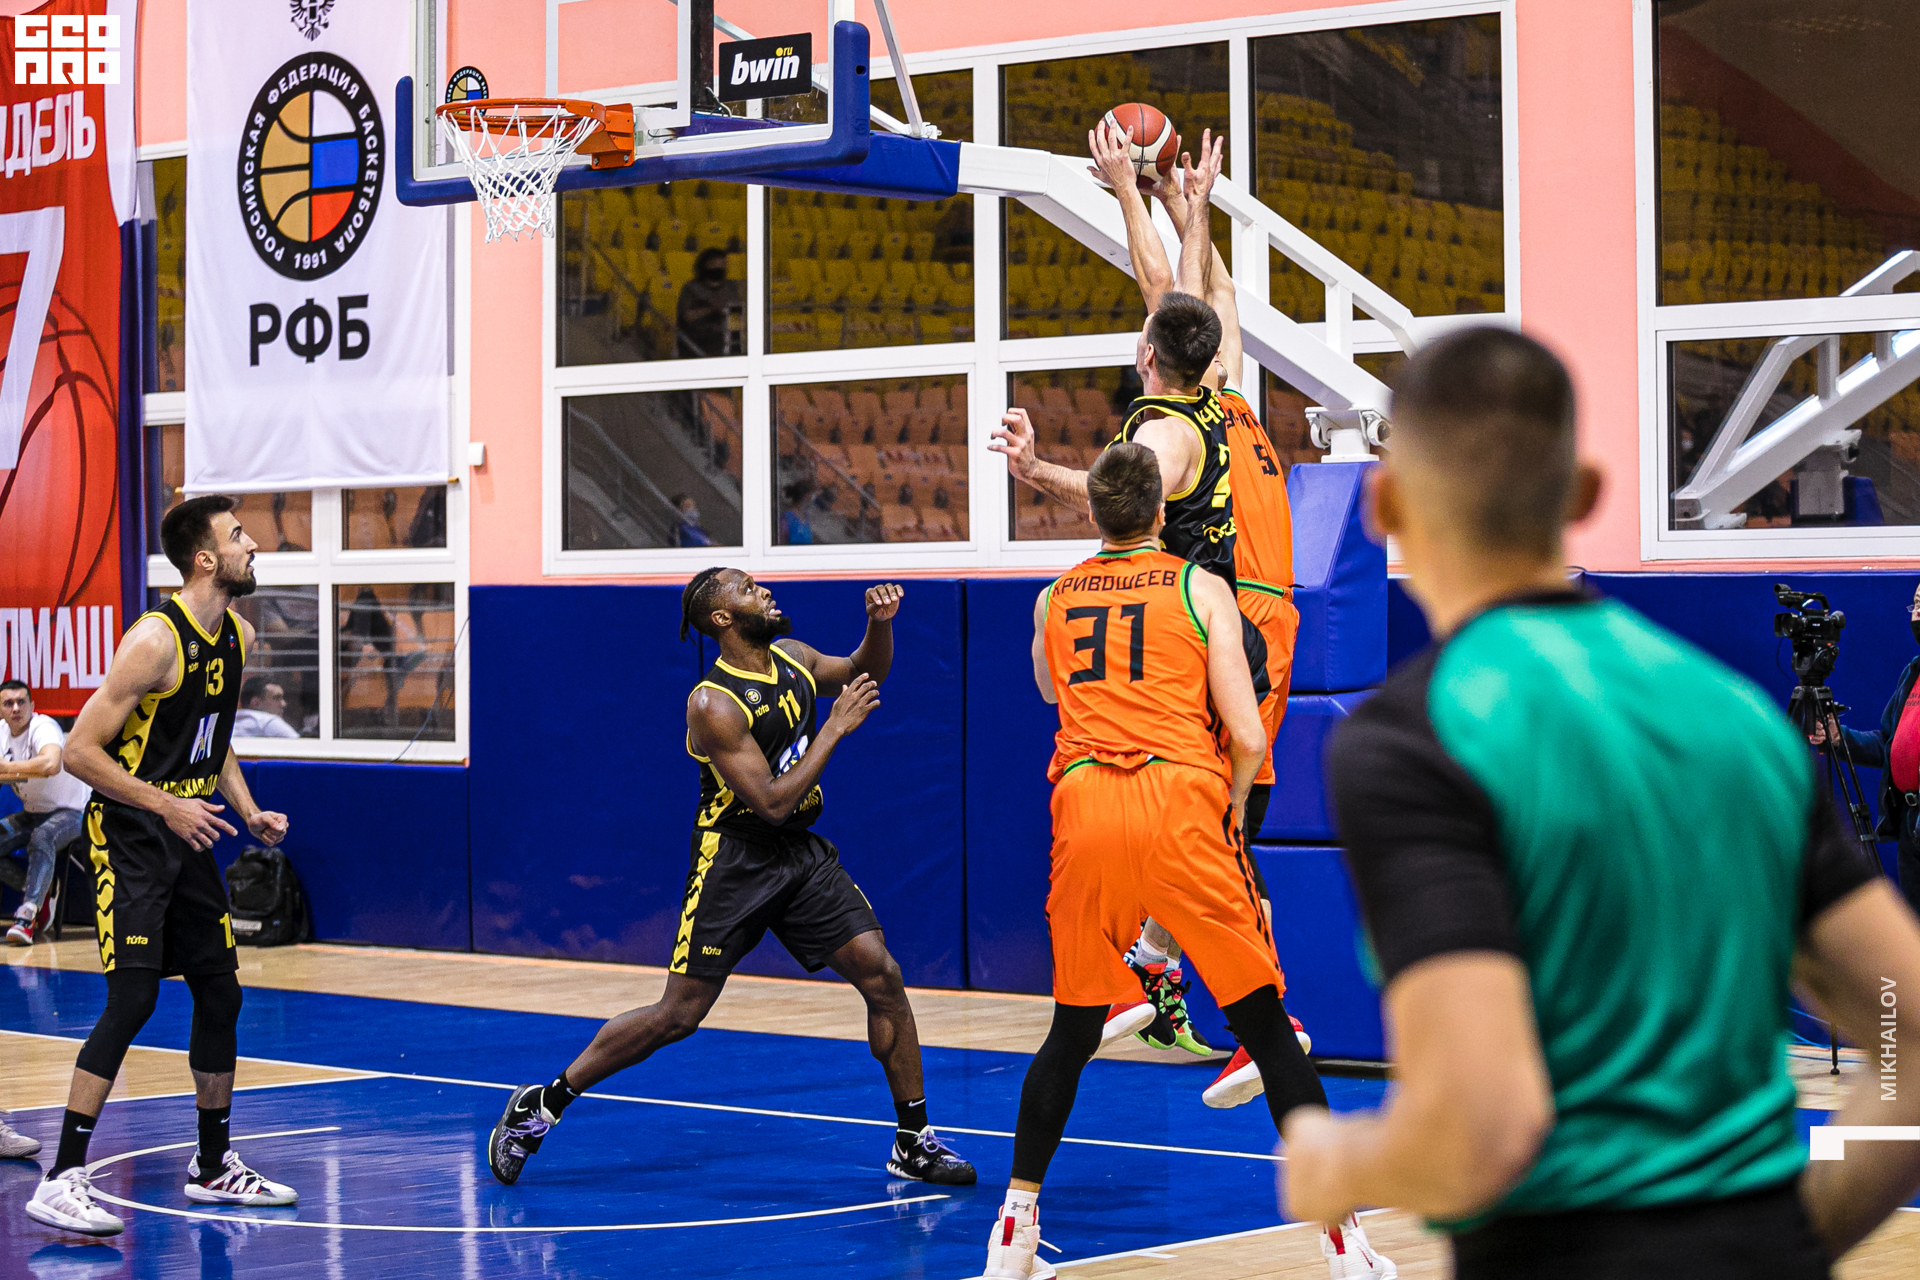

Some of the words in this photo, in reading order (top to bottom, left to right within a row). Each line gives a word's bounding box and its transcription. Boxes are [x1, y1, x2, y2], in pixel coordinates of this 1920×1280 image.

[730, 48, 800, 85] bwin
[242, 111, 286, 262] РОССИЙСКАЯ
[267, 63, 360, 105] ФЕДЕРАЦИЯ
[333, 103, 379, 254] БАСКЕТБОЛА
[293, 249, 328, 270] 1991
[249, 294, 370, 367] РФБ
[1065, 601, 1149, 688] 31
[205, 657, 224, 697] 13
[778, 689, 801, 729] 11
